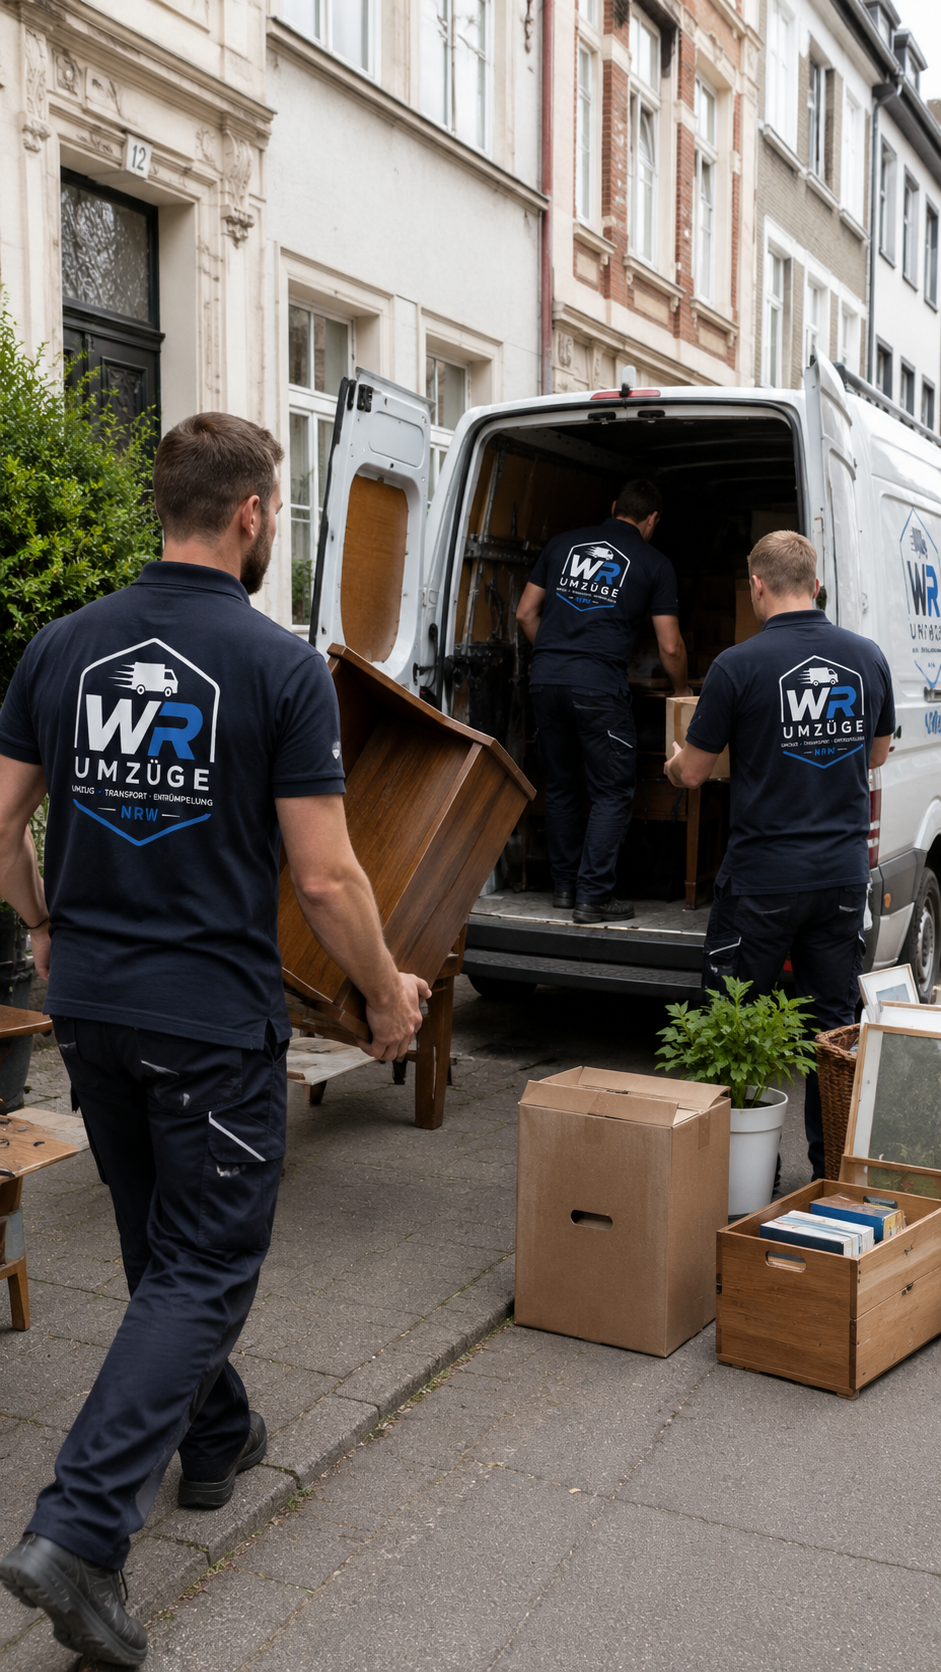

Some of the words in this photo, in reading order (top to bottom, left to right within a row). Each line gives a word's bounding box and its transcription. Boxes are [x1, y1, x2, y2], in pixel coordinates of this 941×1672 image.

[131, 144, 147, 171] 12
[570, 554, 621, 585] WR
[907, 560, 941, 618] WR
[786, 685, 857, 722] WR
[86, 694, 204, 760] WR
[783, 720, 864, 739] UMZÜGE
[74, 756, 210, 791] UMZÜGE
[104, 788, 148, 800] TRANSPORT
[120, 805, 159, 822] NRW
